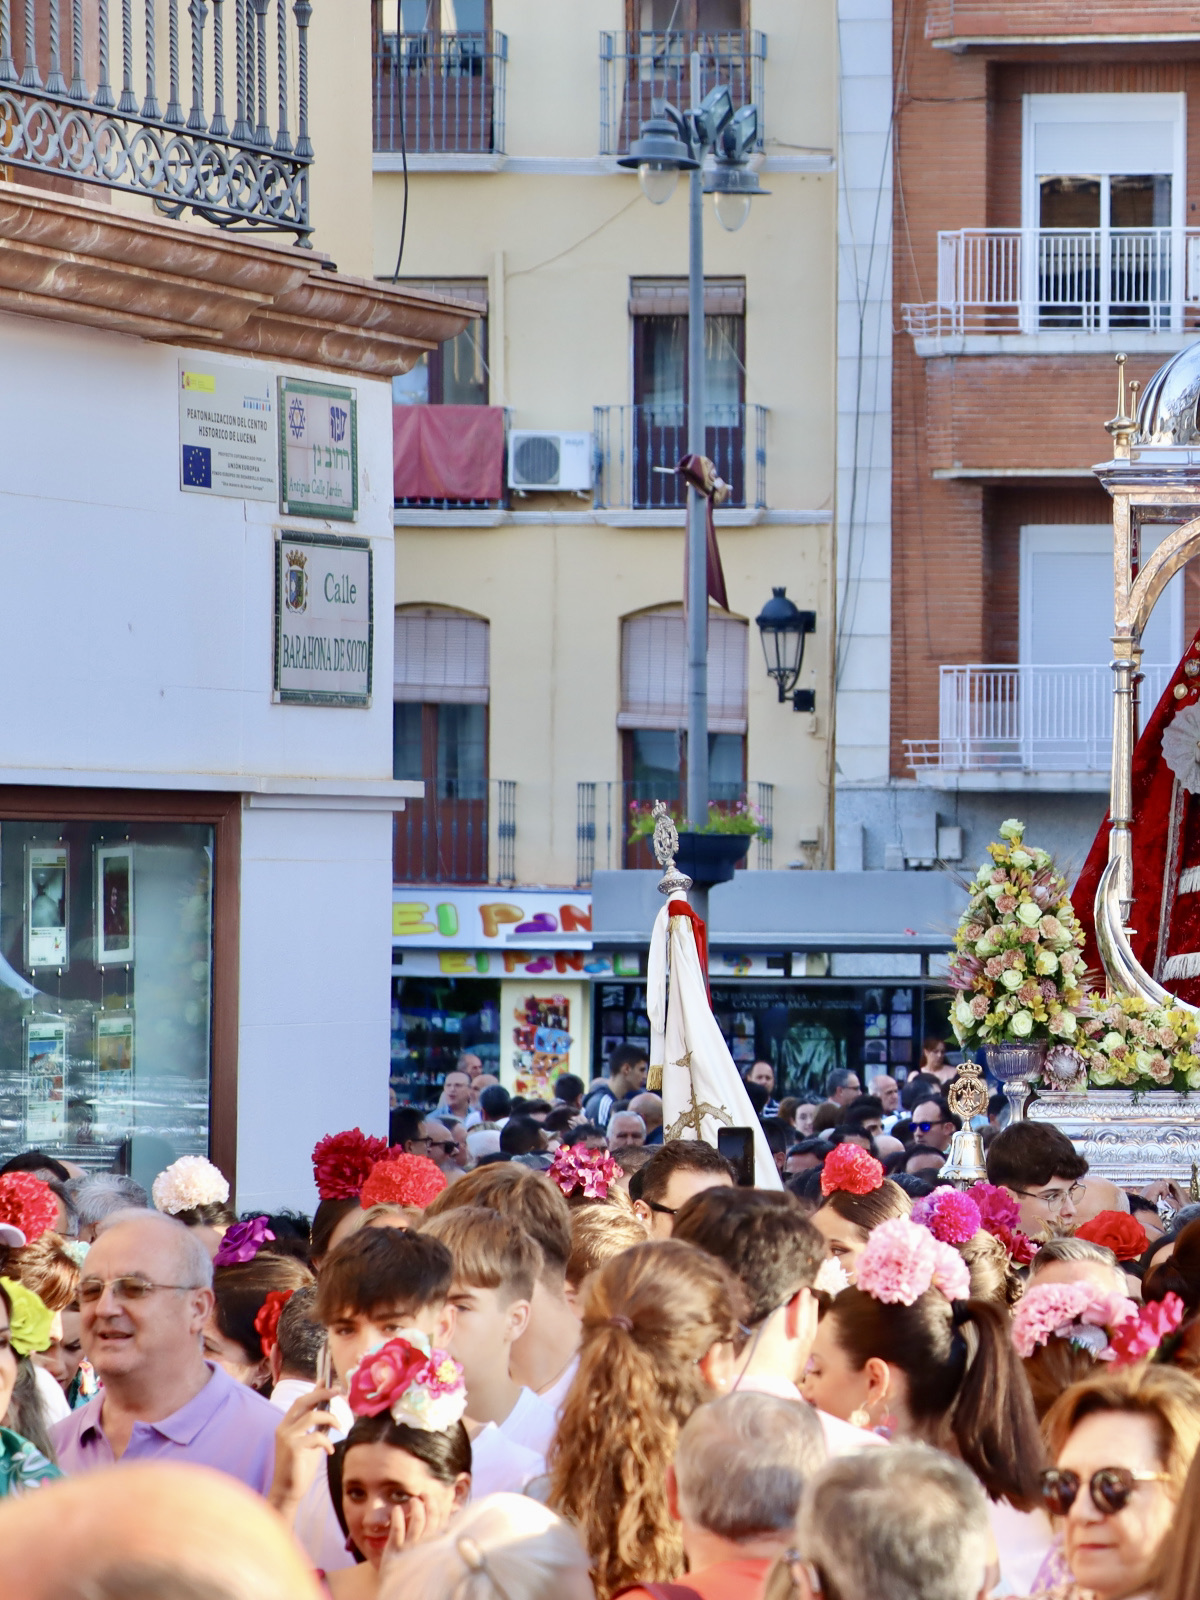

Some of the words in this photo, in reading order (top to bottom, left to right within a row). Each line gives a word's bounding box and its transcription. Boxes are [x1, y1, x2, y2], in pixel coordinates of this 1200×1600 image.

[186, 408, 237, 426] PEATONALIZACION
[237, 416, 247, 428] DEL
[247, 418, 268, 432] CENTRO
[198, 426, 228, 440] HISTORICO
[229, 430, 236, 441] DE
[236, 431, 257, 444] LUCENA
[242, 464, 260, 472] EUROPEA
[289, 479, 311, 498] Antigua
[312, 479, 326, 496] Calle
[323, 572, 357, 604] Calle
[283, 634, 332, 671] BARAHONA
[333, 638, 345, 672] DE
[346, 639, 368, 673] SOTO
